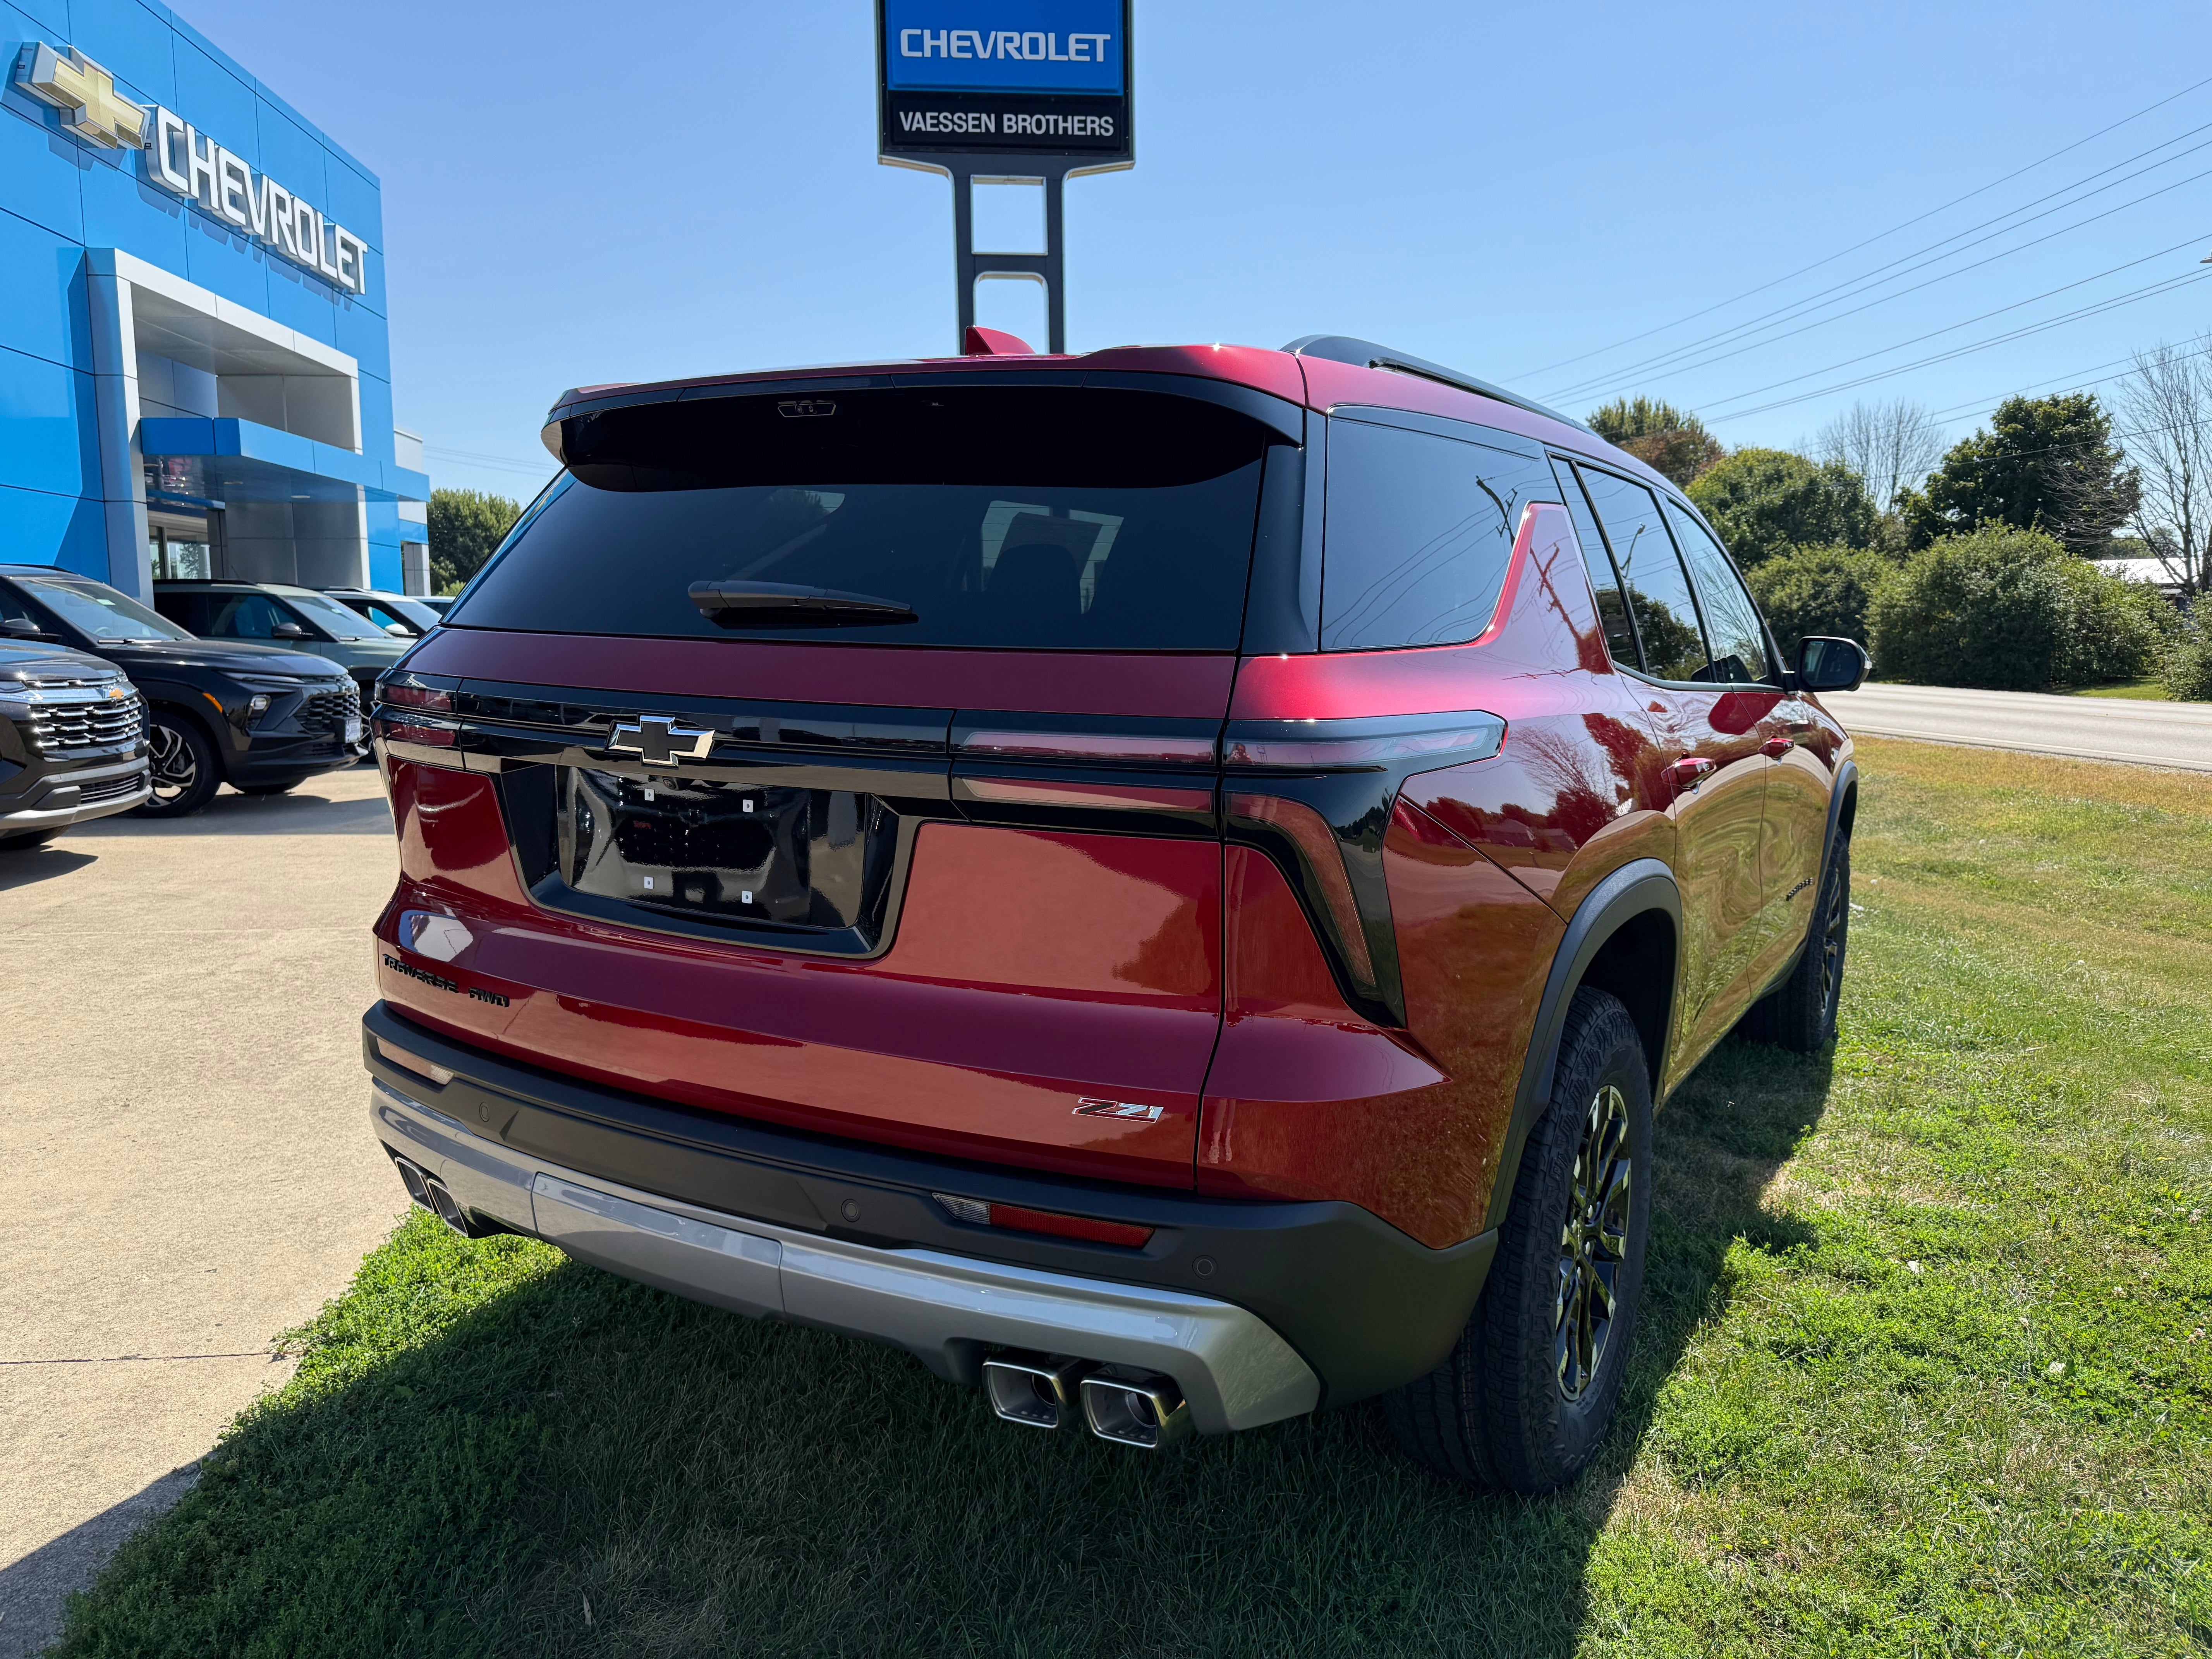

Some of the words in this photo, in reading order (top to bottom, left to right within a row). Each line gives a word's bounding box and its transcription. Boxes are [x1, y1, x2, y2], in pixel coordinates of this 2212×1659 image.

[900, 29, 1111, 62] CHEVROLET
[899, 112, 995, 133] VAESSEN
[1003, 114, 1114, 136] BROTHERS
[152, 105, 368, 295] CHEVROLET
[382, 953, 459, 993] TRAVERSE
[468, 986, 510, 1008] AWD
[1072, 1097, 1164, 1123] Z71
